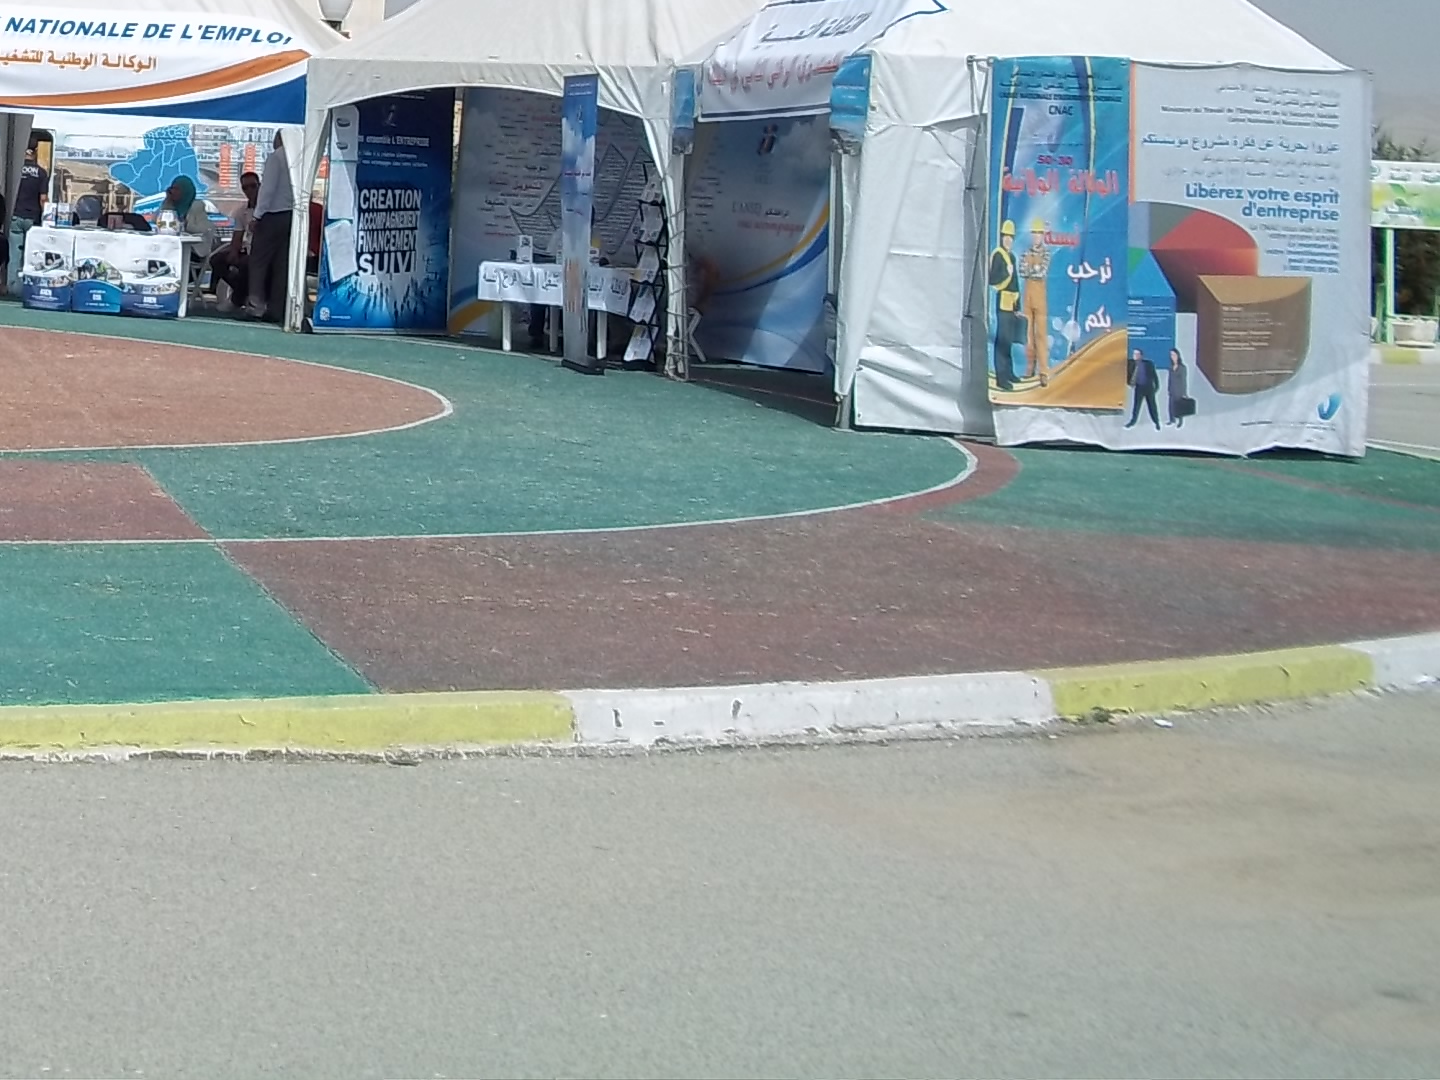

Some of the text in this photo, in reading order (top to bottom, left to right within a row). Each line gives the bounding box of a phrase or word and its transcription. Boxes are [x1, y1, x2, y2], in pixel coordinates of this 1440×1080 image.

[5, 17, 138, 37] NATIONALE
[142, 23, 176, 39] DE
[48, 50, 98, 70] الوطنية
[102, 53, 157, 73] الوكالة
[1048, 105, 1074, 116] CNAC
[359, 189, 421, 209] CREATION
[1185, 182, 1340, 208] Libérez votre esprit
[359, 210, 420, 230] ACCOMPAGNEMENT
[1242, 200, 1340, 224] d'entreprise
[358, 230, 418, 252] FINANCEMENT
[358, 251, 416, 276] SUIVI
[1066, 256, 1112, 284] ترحب
[1084, 304, 1112, 332] بكم
